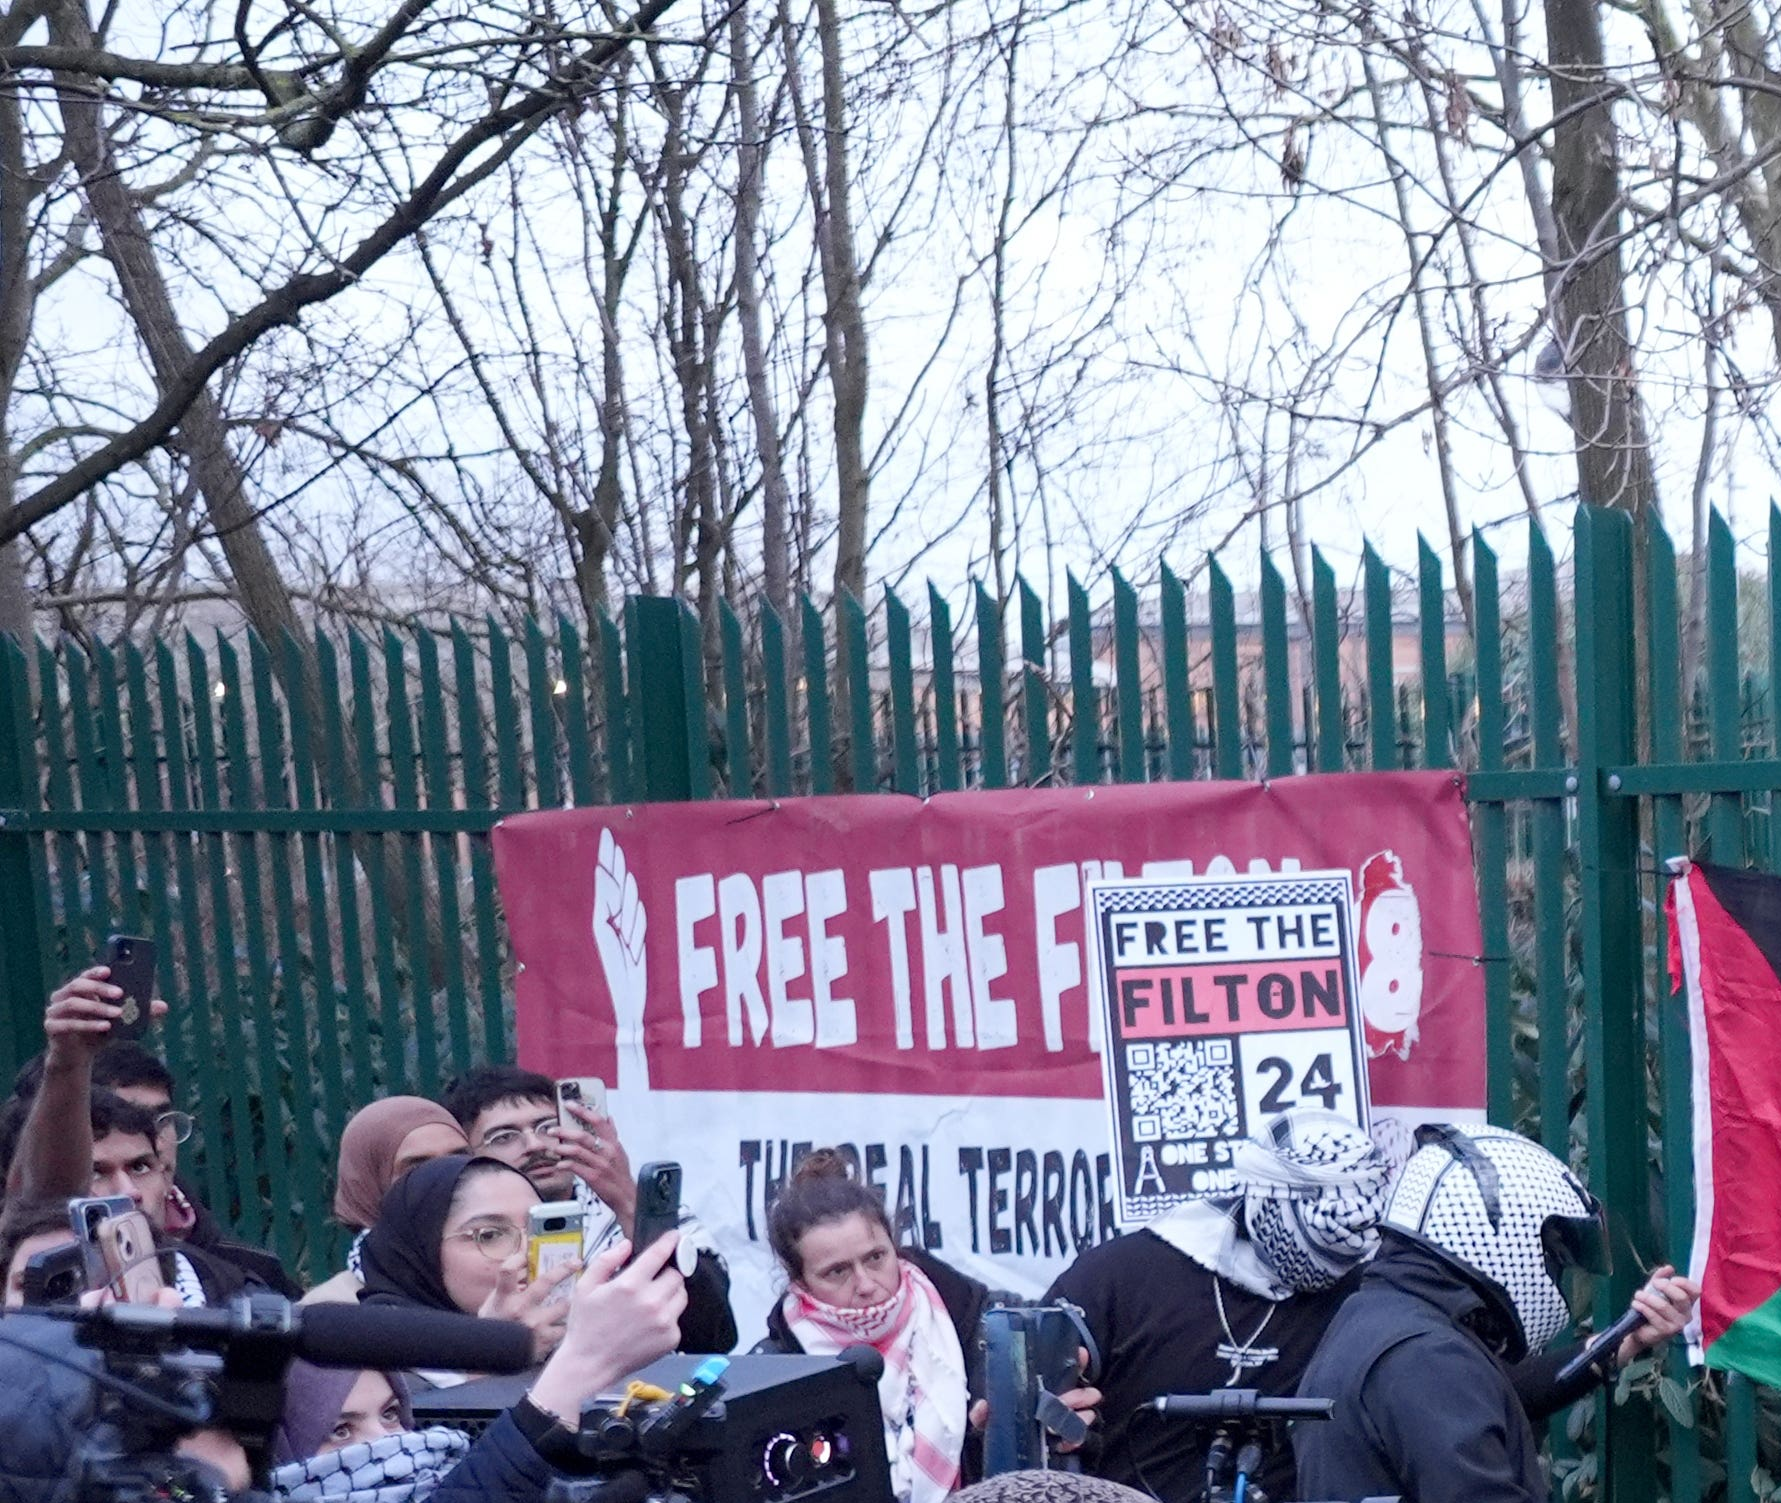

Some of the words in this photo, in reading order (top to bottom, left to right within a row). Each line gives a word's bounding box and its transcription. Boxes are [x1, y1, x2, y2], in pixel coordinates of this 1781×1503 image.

[675, 868, 857, 1049] FREE
[869, 863, 1018, 1051] THE
[1114, 917, 1229, 957] FREE
[1247, 913, 1335, 951] THE
[1121, 969, 1341, 1028] FILTON
[1256, 1053, 1343, 1114] 24
[1160, 1143, 1208, 1166] ONE
